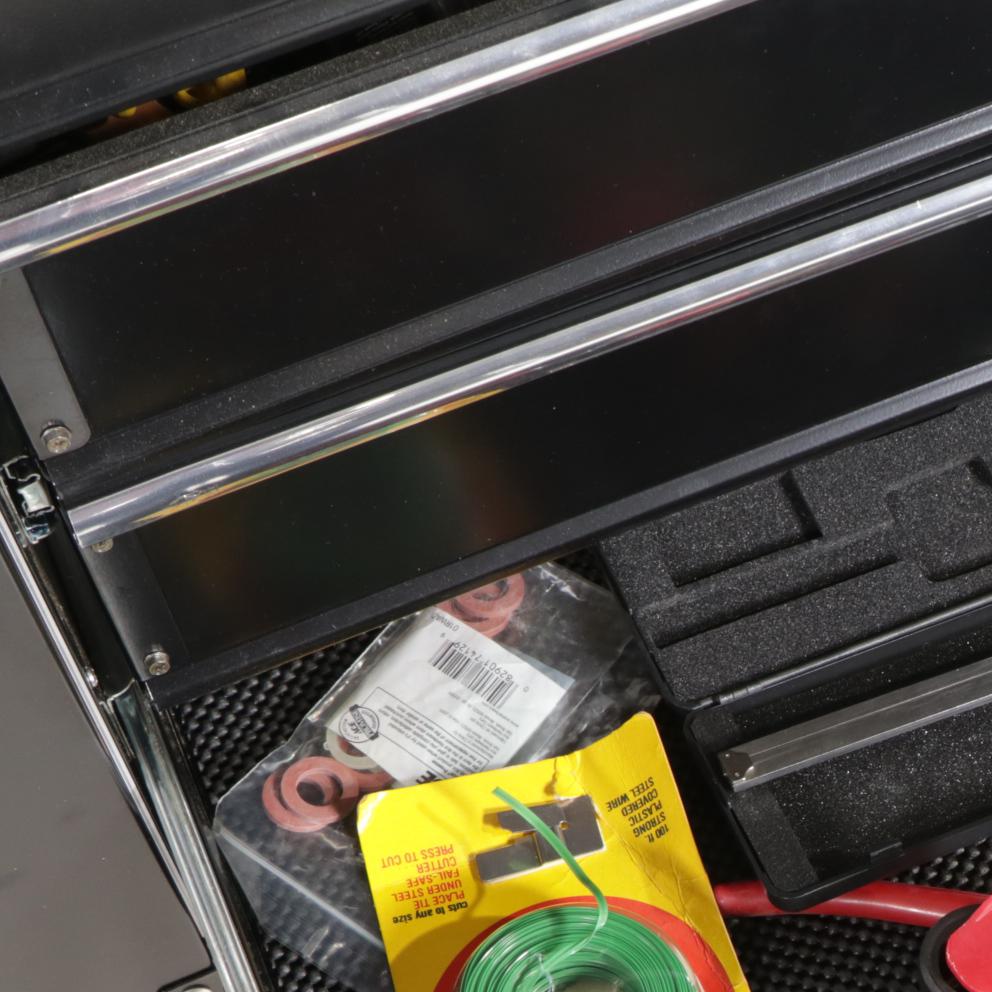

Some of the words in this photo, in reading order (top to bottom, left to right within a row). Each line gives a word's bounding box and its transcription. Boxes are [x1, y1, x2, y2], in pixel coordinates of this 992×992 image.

[629, 776, 655, 797] STEEL
[606, 793, 630, 812] WIRE
[621, 788, 659, 817] COVERED
[628, 800, 663, 827] PLASTIC
[632, 812, 667, 838] STRONG
[655, 824, 670, 839] 100
[404, 852, 417, 864] TO
[420, 844, 454, 860] PRESS
[381, 854, 402, 868] CUT
[416, 856, 457, 873] CUTTER
[407, 868, 460, 888] FAIL-SAFE
[391, 886, 425, 902] STEEL
[427, 879, 462, 895] UNDER
[414, 898, 430, 910] TIE
[433, 890, 465, 905] PLACE
[435, 906, 446, 915] to
[447, 901, 468, 912] cuts
[392, 913, 413, 924] size
[415, 910, 433, 920] any
